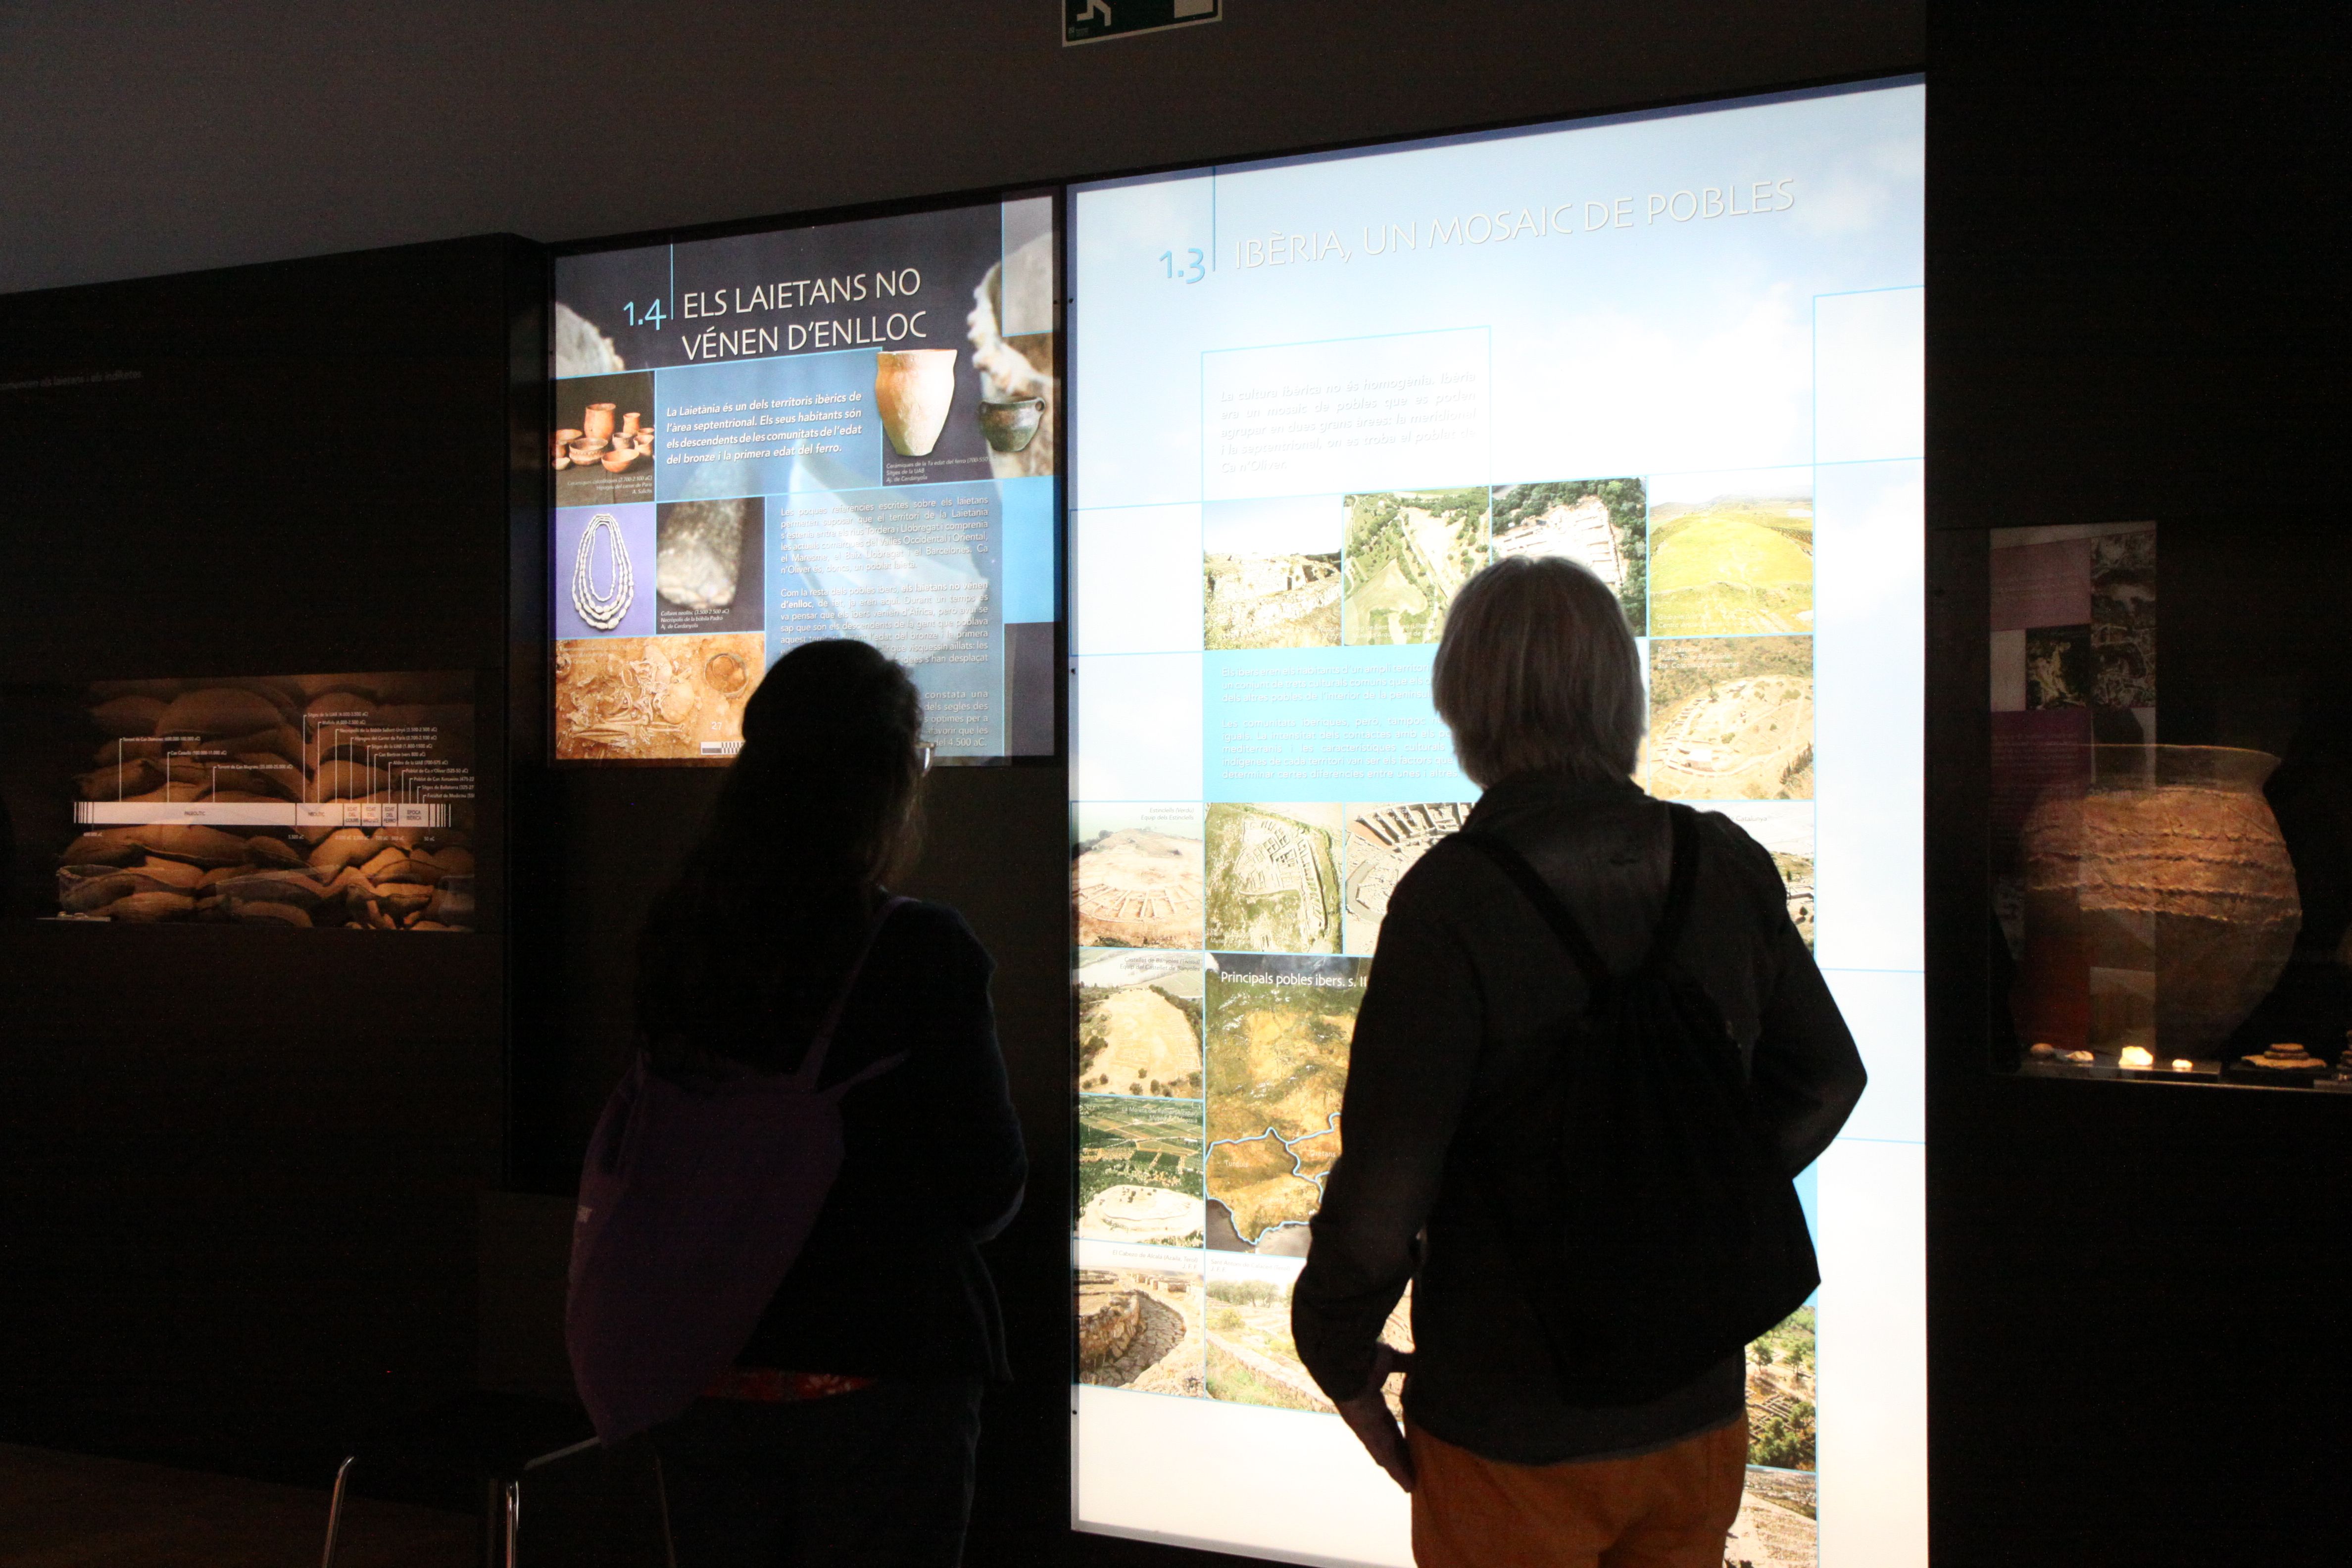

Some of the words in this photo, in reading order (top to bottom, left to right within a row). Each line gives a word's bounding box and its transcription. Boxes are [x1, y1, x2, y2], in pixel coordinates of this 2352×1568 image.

[1236, 230, 1352, 270] IBÈRIA,
[1364, 221, 1417, 256] UN
[1428, 203, 1573, 249] MOSAIC
[1585, 196, 1634, 232] DE
[1648, 178, 1795, 225] POBLES
[1160, 248, 1205, 284] 1.3
[685, 289, 727, 319] ELS
[736, 274, 866, 313] LAIETANS
[877, 269, 920, 298] NO
[623, 298, 667, 331] 1.4
[682, 326, 778, 360] VÉNEN
[788, 311, 926, 350] D'ENLLOC
[1221, 391, 1234, 402] La
[1239, 388, 1277, 400] cultura
[1282, 385, 1322, 397] ibèrica
[1346, 381, 1359, 392] és
[1364, 375, 1435, 391] homogènia.
[1441, 372, 1475, 384] Ibèria
[667, 407, 677, 417] La
[680, 404, 720, 416] Laietània
[723, 402, 733, 412] és
[749, 399, 769, 410] dels
[771, 396, 812, 408] territoris
[815, 393, 846, 404] ibèrics
[849, 392, 862, 401] de
[1221, 411, 1239, 420] era
[1267, 403, 1307, 416] mosaic
[1315, 400, 1329, 413] de
[1336, 397, 1377, 414] pobles
[1385, 398, 1408, 410] que
[1416, 396, 1428, 405] es
[1435, 390, 1475, 406] poden
[667, 423, 691, 433] l'àrea
[693, 416, 757, 432] septentrional.
[760, 415, 773, 425] Els
[775, 416, 796, 424] seus
[798, 410, 842, 422] habitants
[844, 408, 861, 418] són
[1221, 427, 1267, 441] agrupar
[1288, 421, 1316, 433] dues
[1320, 421, 1352, 434] grans
[1356, 417, 1392, 428] àrees:
[1396, 413, 1406, 425] la
[1410, 407, 1476, 424] meridional
[666, 438, 679, 448] els
[680, 435, 738, 447] descendents
[739, 433, 751, 443] de
[752, 432, 766, 442] les
[767, 429, 819, 441] comunitats
[820, 427, 832, 437] de
[833, 425, 862, 436] l'edat
[1221, 445, 1225, 455] i
[1228, 443, 1238, 455] la
[1241, 437, 1322, 456] septentrional,
[1327, 439, 1342, 448] on
[1364, 433, 1396, 445] troba
[1401, 431, 1412, 443] el
[1415, 428, 1456, 445] poblat
[1461, 427, 1473, 438] de
[666, 454, 681, 464] del
[684, 453, 715, 463] bronze
[718, 451, 721, 460] i
[723, 450, 731, 460] la
[734, 449, 771, 462] primera
[773, 446, 795, 456] edat
[798, 444, 813, 454] del
[816, 443, 842, 453] ferro.
[1222, 462, 1236, 473] Ca
[1240, 460, 1287, 472] n'Oliver.
[781, 508, 794, 518] Les
[798, 508, 826, 517] poques
[913, 500, 936, 510] sobre
[810, 588, 828, 596] resta
[848, 586, 875, 596] pobles
[877, 585, 899, 594] ibers,
[915, 583, 947, 591] laietans
[944, 702, 971, 713] segles
[711, 722, 722, 731] 27
[1222, 770, 1275, 778] determinar
[1277, 769, 1307, 778] certes
[1311, 769, 1364, 778] diferències
[1367, 769, 1393, 778] entre
[1423, 769, 1426, 778] i
[1429, 769, 1460, 778] altres.
[1222, 972, 1273, 986] Principals
[1276, 974, 1313, 987] pobles
[1316, 975, 1345, 987] ibers.
[1348, 978, 1357, 987] s.
